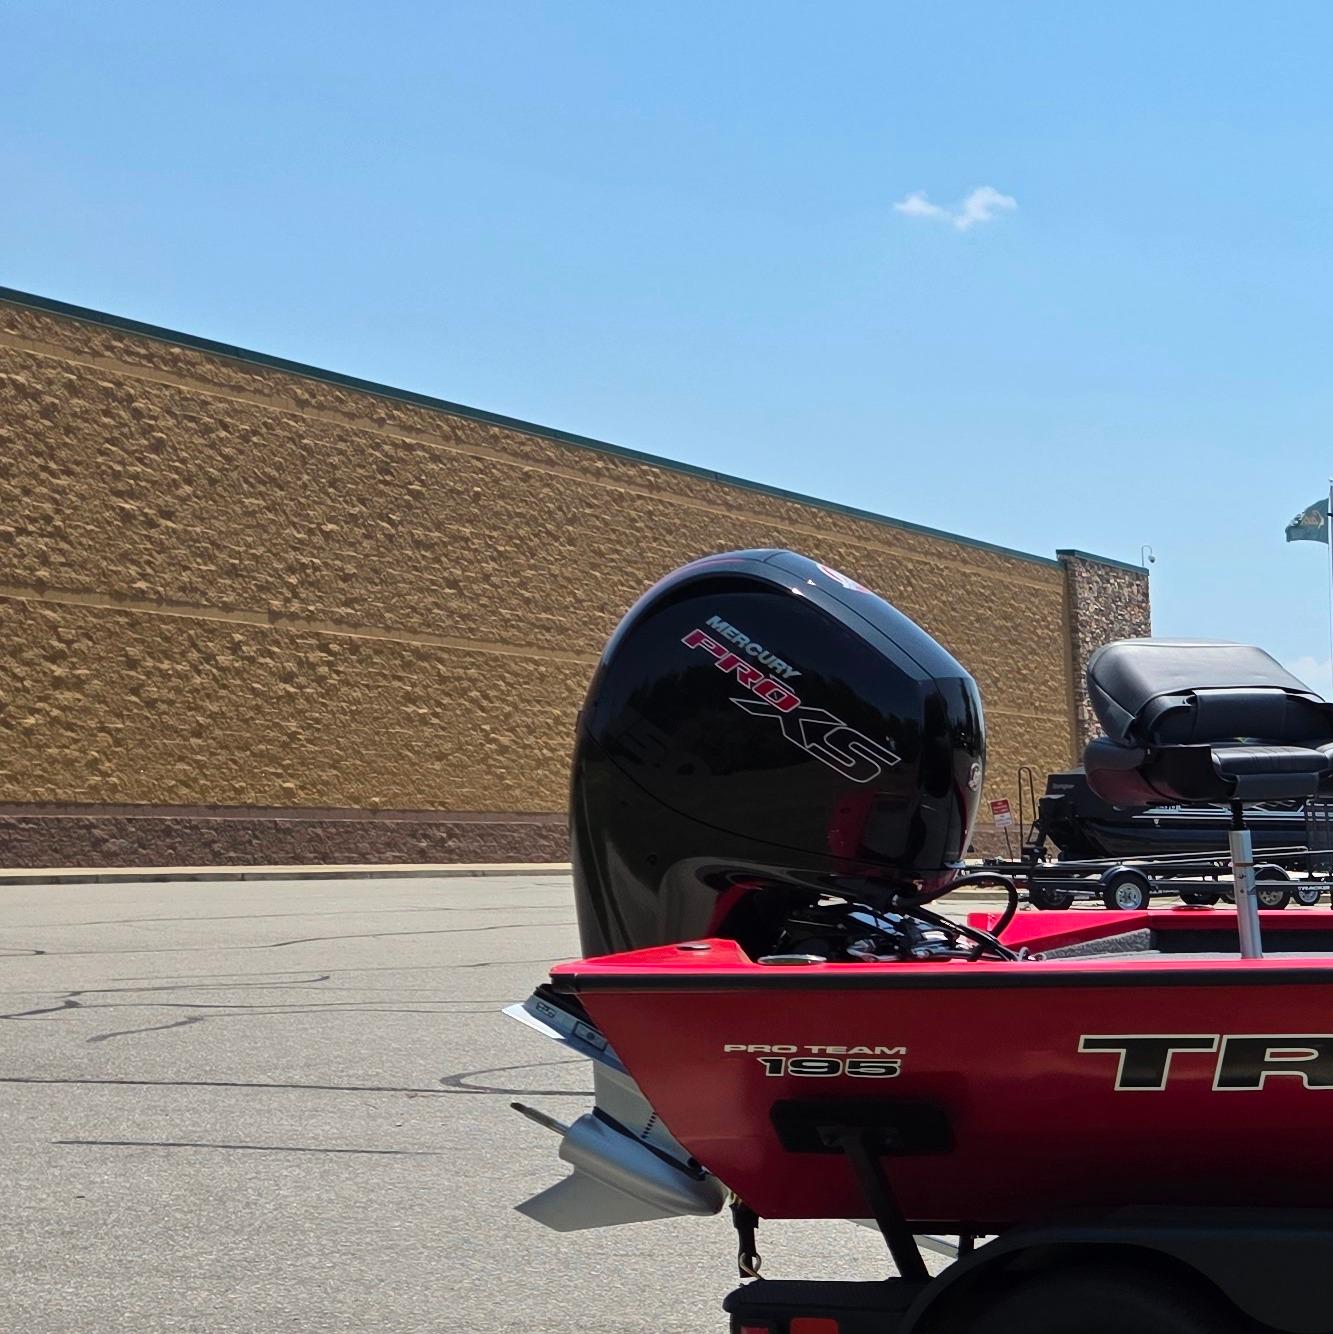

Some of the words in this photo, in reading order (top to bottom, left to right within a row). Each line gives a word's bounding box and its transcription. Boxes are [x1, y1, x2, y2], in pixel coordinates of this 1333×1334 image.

[681, 629, 801, 712] PRO
[706, 615, 801, 679] MERCURY
[728, 697, 901, 783] XS
[724, 1044, 798, 1053] PRO
[804, 1045, 907, 1055] TEAM
[756, 1056, 901, 1078] 195
